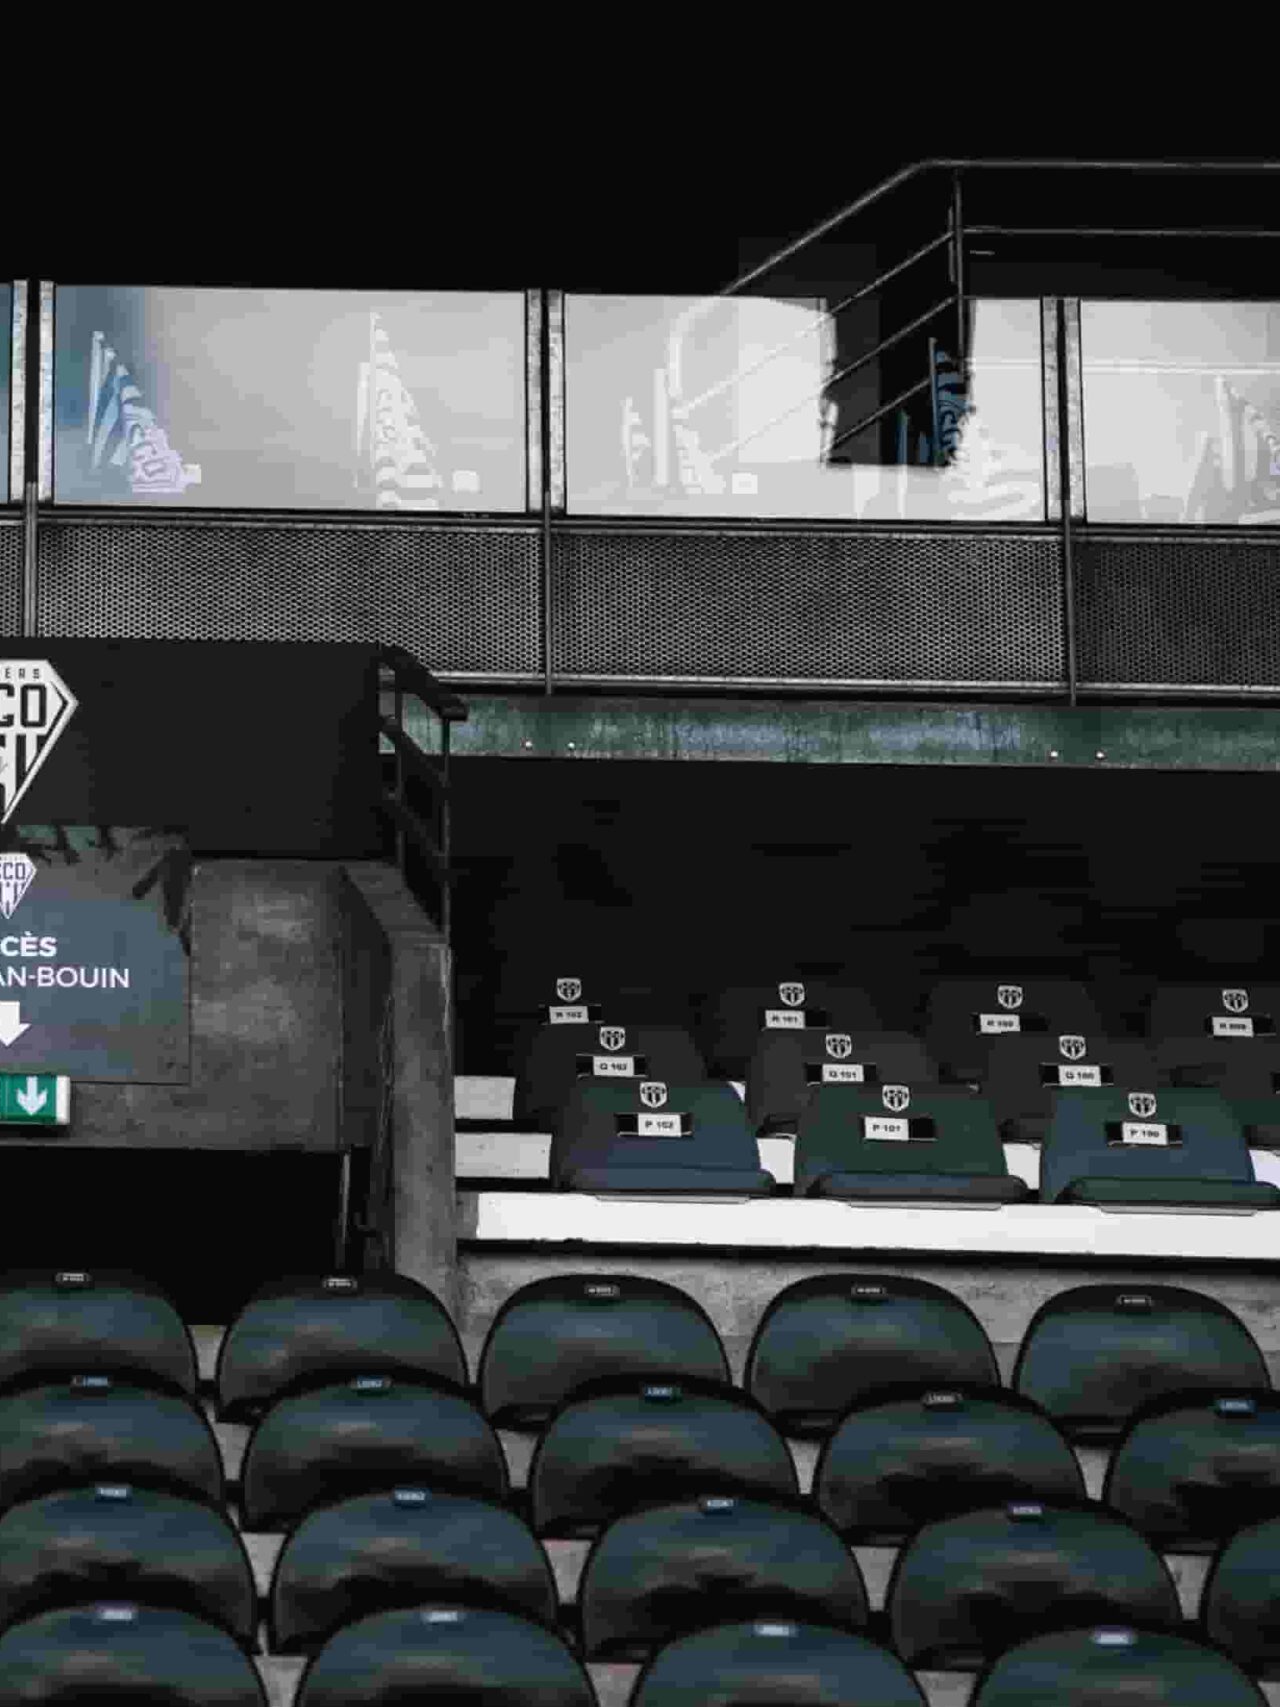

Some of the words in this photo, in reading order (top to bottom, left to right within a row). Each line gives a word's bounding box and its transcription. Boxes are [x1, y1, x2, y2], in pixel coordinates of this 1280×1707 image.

[644, 1120, 654, 1128] P
[872, 1124, 881, 1132] P
[1130, 1130, 1139, 1138] P
